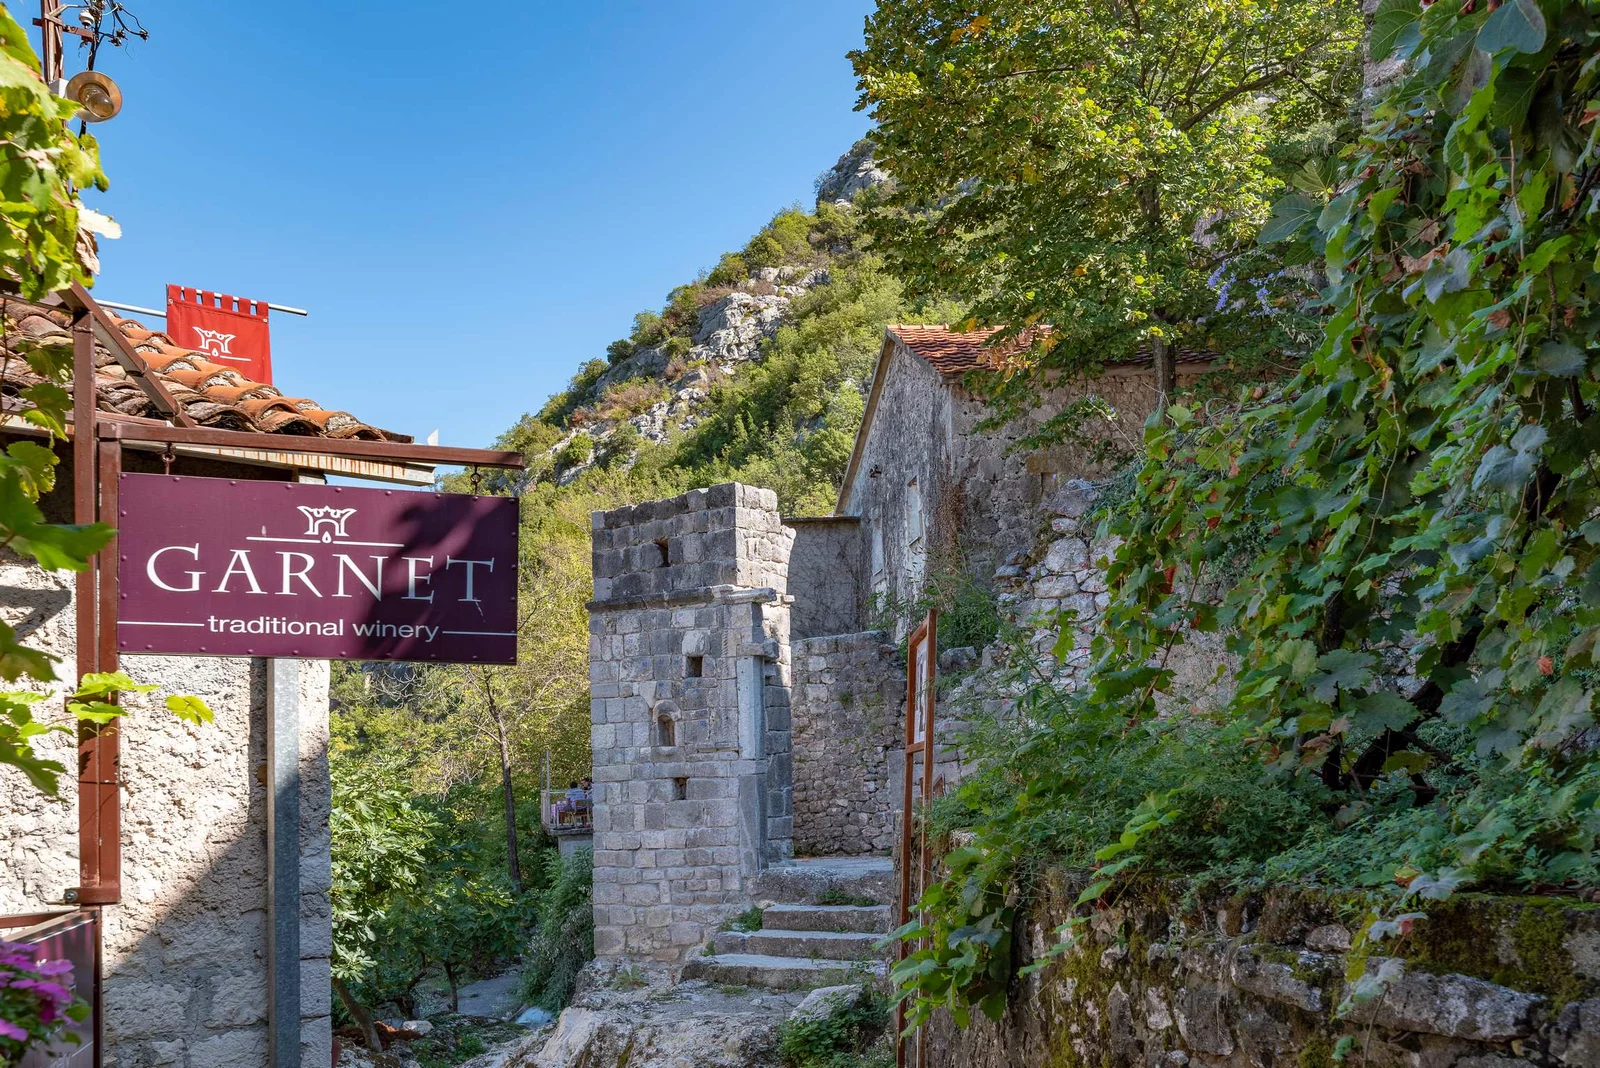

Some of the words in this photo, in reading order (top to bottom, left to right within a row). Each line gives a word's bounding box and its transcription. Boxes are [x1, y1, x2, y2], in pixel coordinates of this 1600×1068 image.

[146, 542, 495, 604] GARNET
[207, 615, 344, 637] traditional
[352, 621, 440, 642] winery
